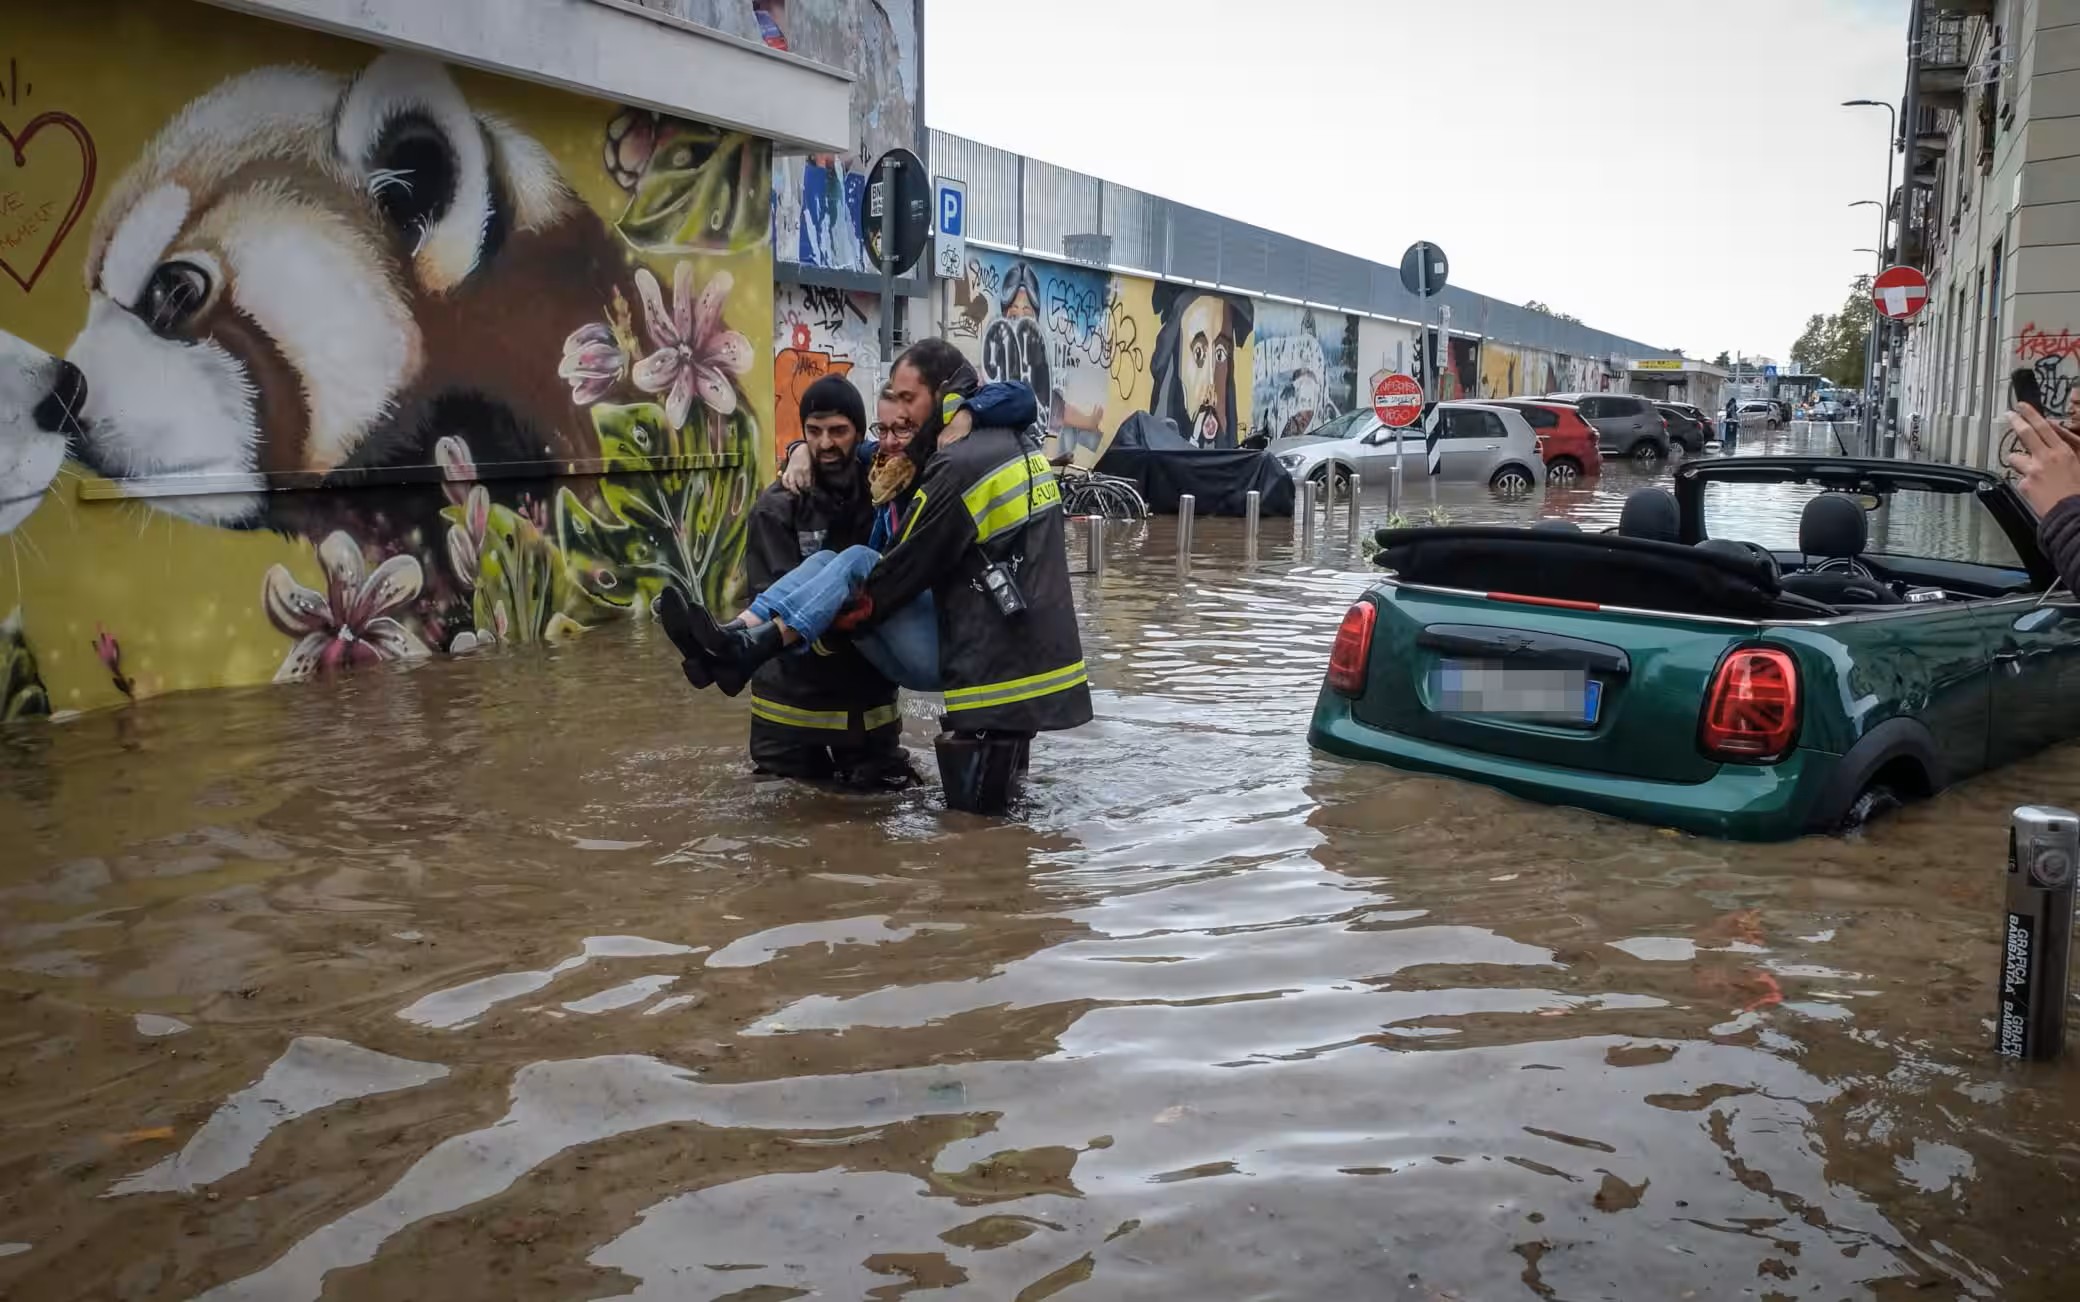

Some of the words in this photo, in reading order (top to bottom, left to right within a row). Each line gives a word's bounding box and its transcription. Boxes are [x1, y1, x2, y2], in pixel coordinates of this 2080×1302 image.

[944, 192, 958, 230] P
[2005, 914, 2019, 993] BAMBAATAA
[2015, 928, 2029, 985] GRAFICA
[2001, 1000, 2014, 1055] BAMBAA
